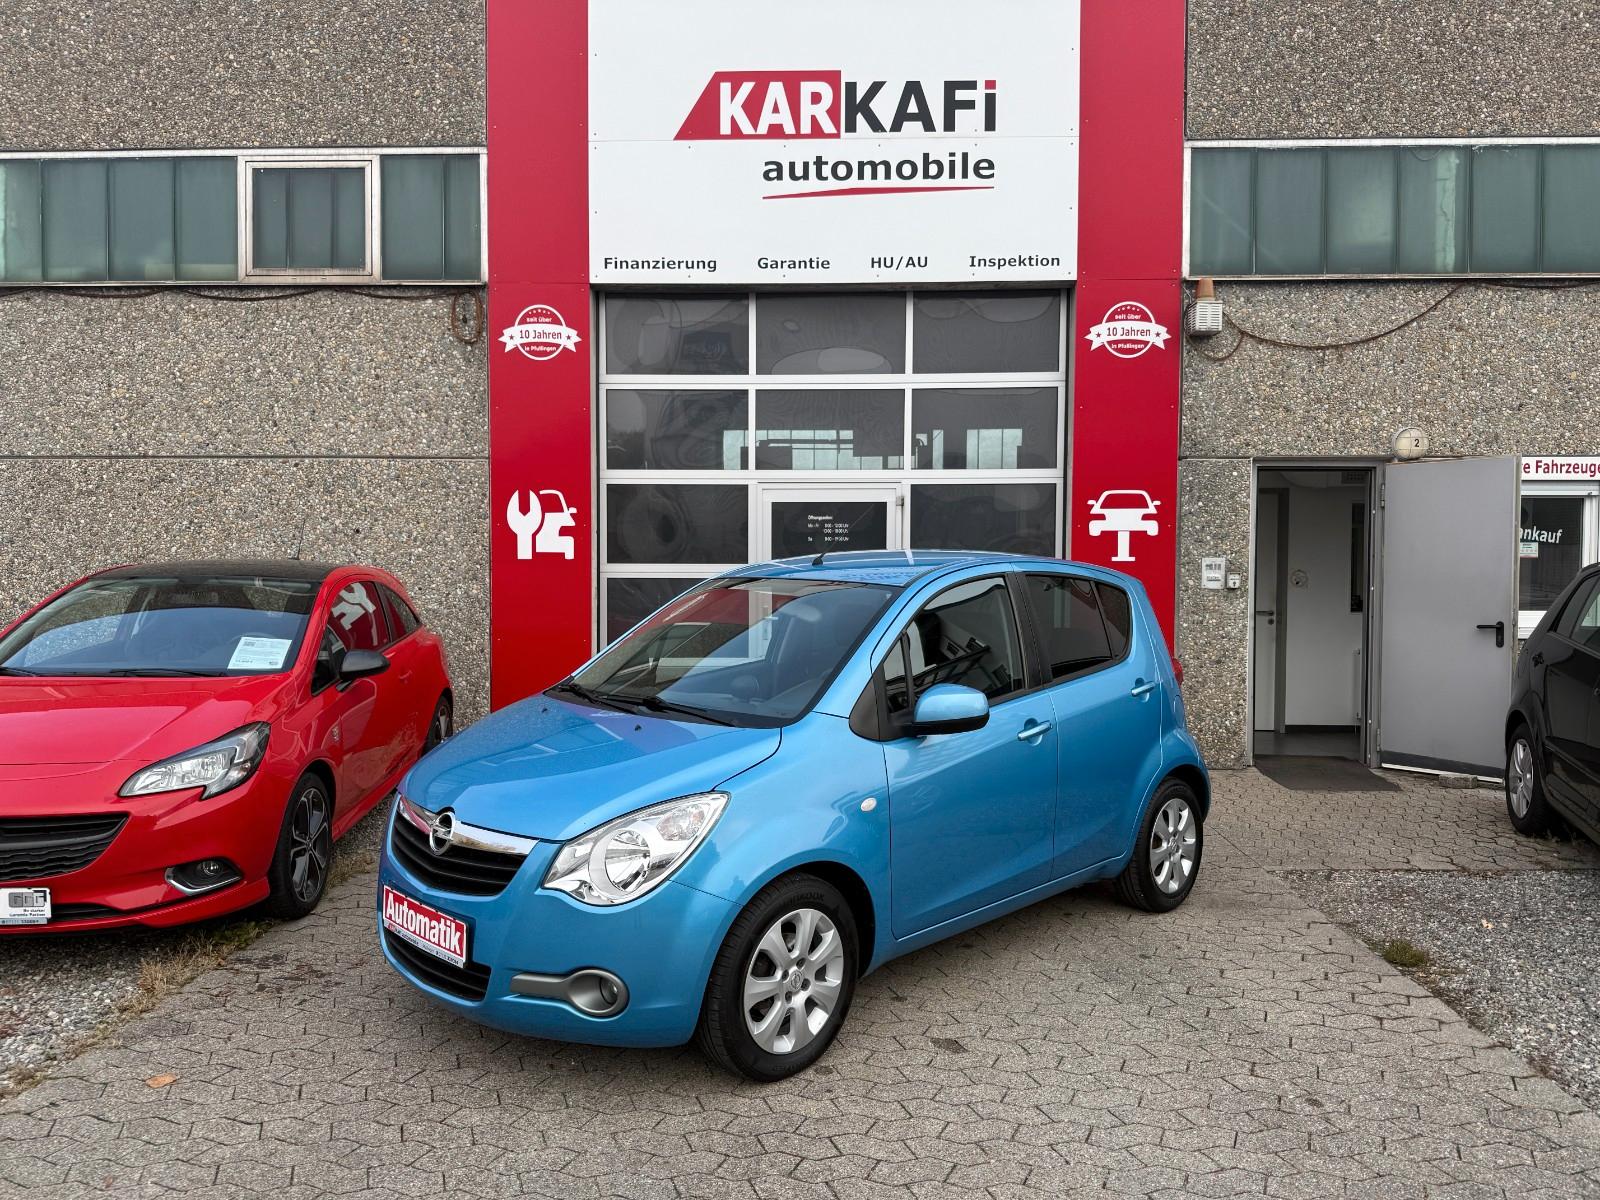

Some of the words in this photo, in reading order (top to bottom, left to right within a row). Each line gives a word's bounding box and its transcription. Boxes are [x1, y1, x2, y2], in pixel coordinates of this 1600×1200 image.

[762, 151, 996, 182] automobile
[603, 256, 718, 273] Finanzierung
[757, 256, 831, 270] Garantie
[870, 256, 929, 271] HU/AU
[969, 254, 1061, 270] Inspektion
[519, 329, 530, 340] 10
[532, 329, 562, 340] Jahren
[1106, 327, 1117, 337] 10
[1120, 326, 1151, 337] Jahren
[1413, 438, 1421, 448] 2
[386, 892, 461, 955] Automatik
